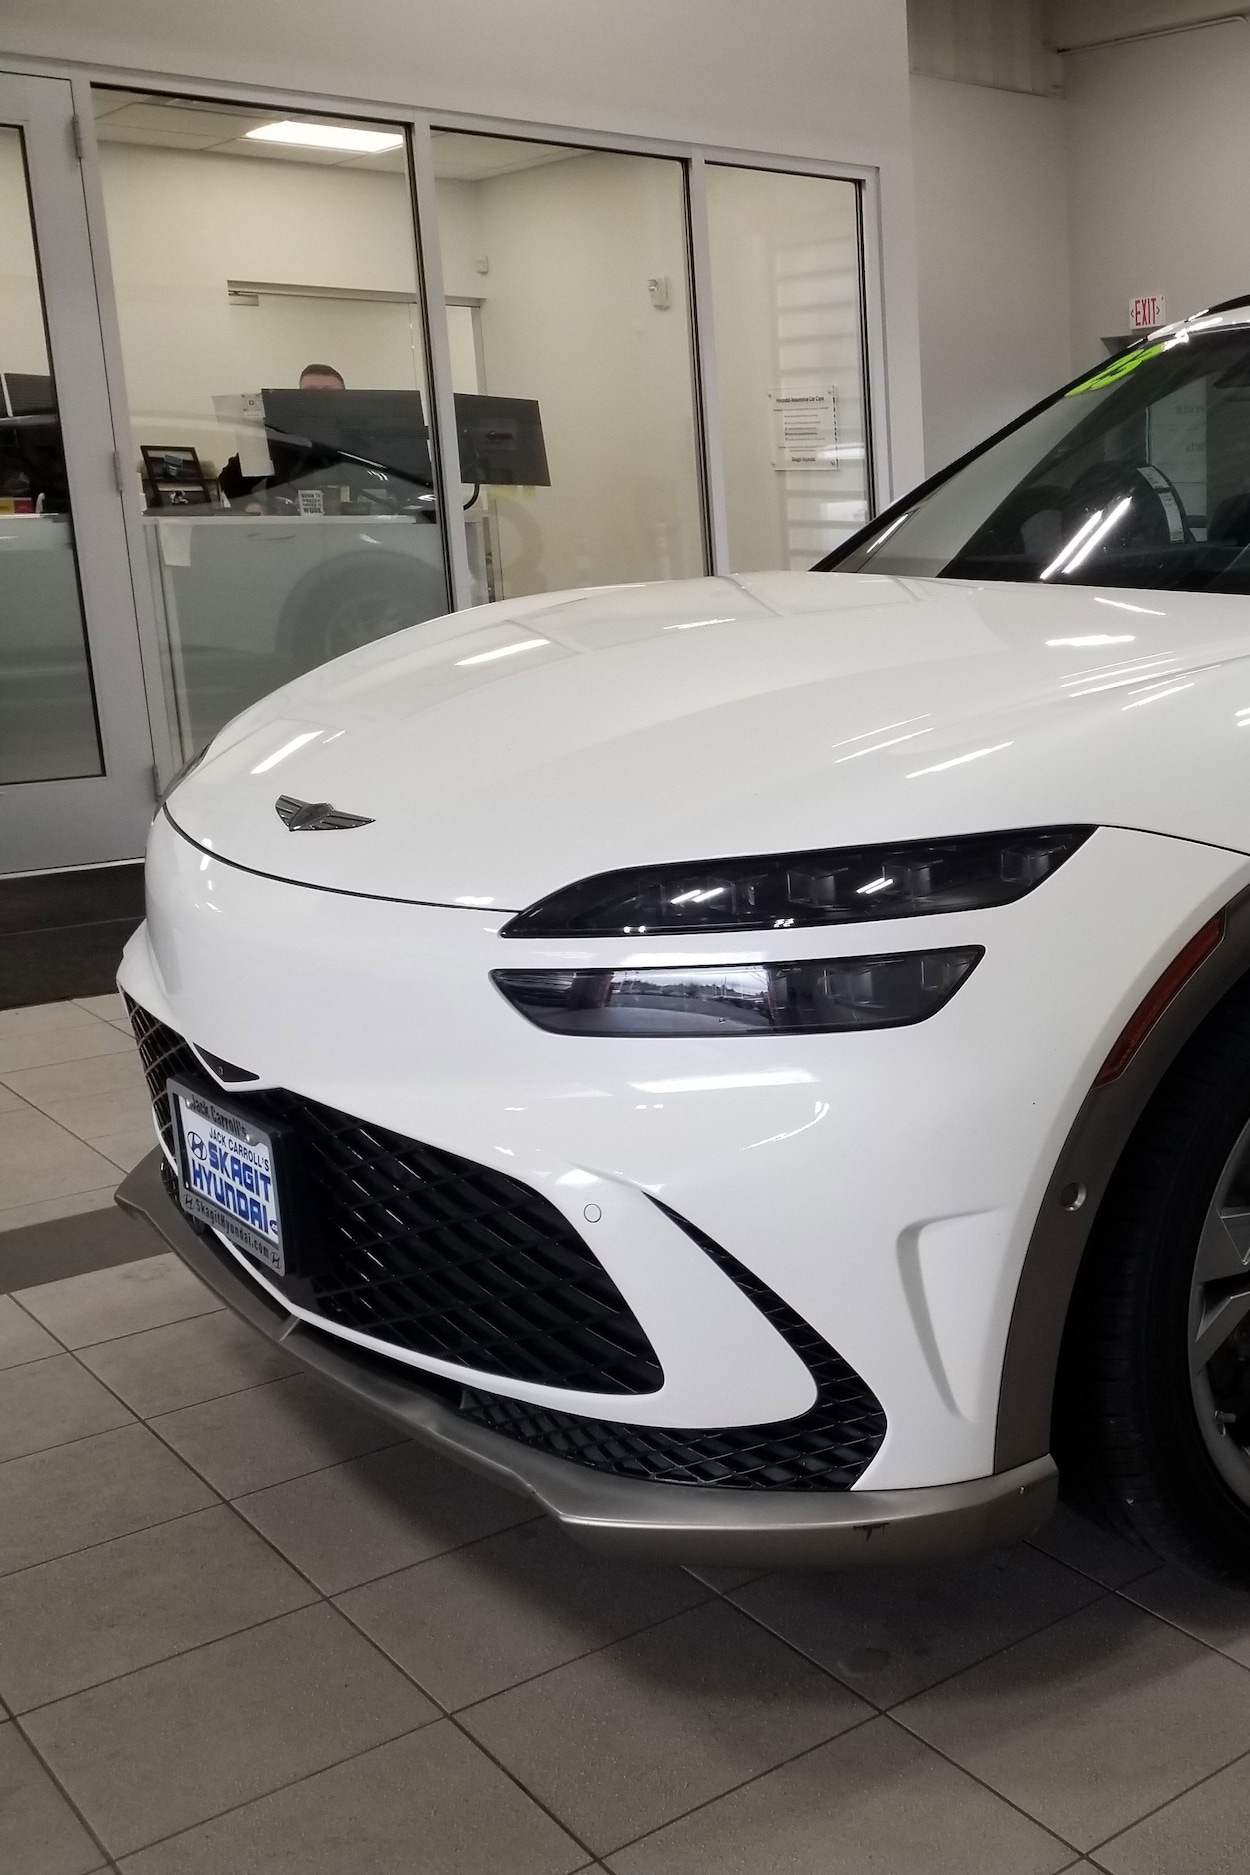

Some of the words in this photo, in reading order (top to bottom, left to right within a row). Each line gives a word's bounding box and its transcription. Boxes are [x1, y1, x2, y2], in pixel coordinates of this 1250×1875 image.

[1135, 298, 1157, 326] EXIT
[191, 1094, 210, 1119] Jack
[208, 1141, 271, 1202] SKAGIT
[209, 1128, 226, 1147] JACK
[228, 1138, 270, 1172] CARROLL'S
[191, 1158, 269, 1235] HYUNDAI
[196, 1199, 270, 1259] SkagitHyundai.com
